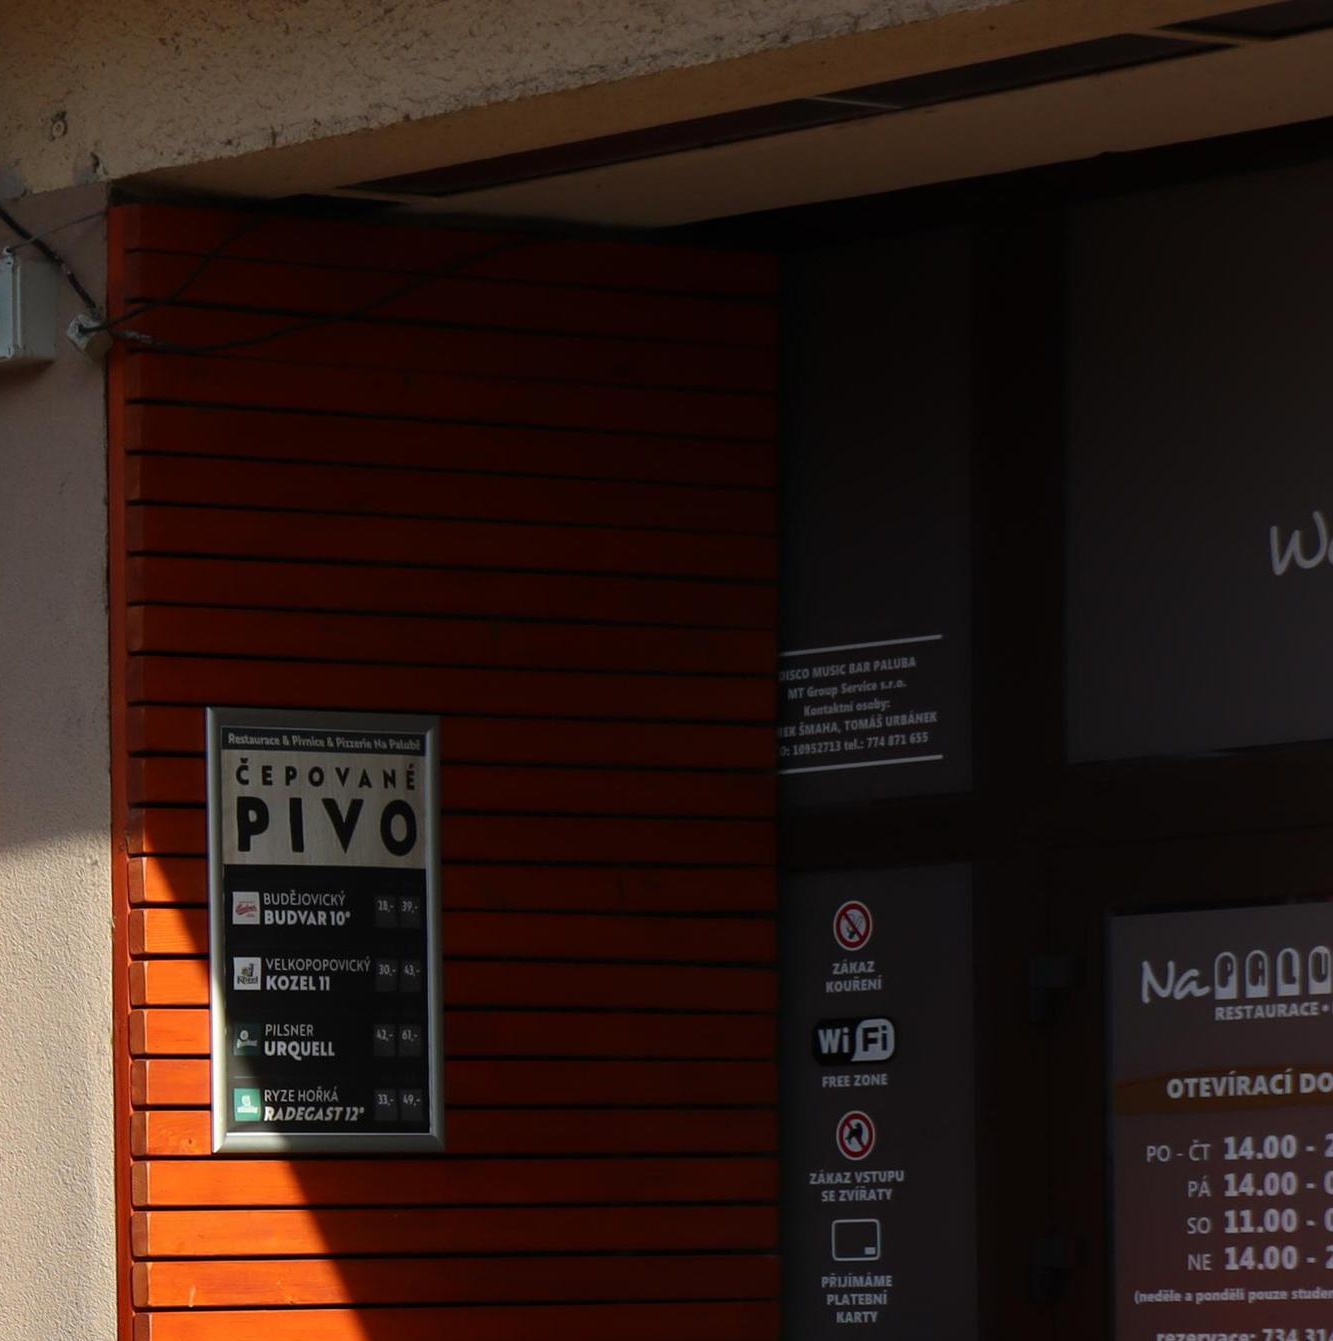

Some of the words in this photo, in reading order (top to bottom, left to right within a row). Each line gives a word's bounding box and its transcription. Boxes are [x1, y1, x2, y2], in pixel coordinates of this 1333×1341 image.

[813, 664, 846, 678] MUSIC
[849, 661, 871, 674] BAR
[873, 656, 917, 671] PALUBA
[788, 687, 804, 700] MT
[807, 684, 838, 698] Group
[841, 680, 878, 695] Service
[880, 680, 907, 690] s.r.o.
[844, 717, 883, 732] TOMÁŠ
[885, 710, 938, 727] URBÁNEK
[228, 732, 281, 745] Restaurace
[282, 735, 291, 745] &
[292, 735, 325, 747] Pivnice
[326, 736, 334, 747] &
[335, 736, 372, 749] Pizzerie
[374, 738, 388, 749] Na
[867, 737, 886, 748] 774
[909, 732, 929, 744] 655
[236, 757, 415, 790] ČEPOVANÉ
[236, 796, 417, 856] PIVO
[263, 890, 346, 906] BUDĚJOVICKÝ
[264, 910, 327, 926] BUDVAR
[265, 956, 371, 972] VELKOPOPOVICKÝ
[832, 958, 875, 975] ZÁKAZ
[265, 976, 317, 991] KOZEL
[319, 976, 331, 991] 11
[825, 974, 883, 993] KOUŘENÍ
[1141, 960, 1211, 1004] Na
[1214, 1002, 1320, 1020] RESTAURACE
[265, 1024, 314, 1037] PILSNER
[264, 1041, 335, 1060] URQUELL
[821, 1075, 851, 1088] FREE
[853, 1073, 889, 1087] ZONE
[1166, 1068, 1294, 1099] OTEVÍRACÍ
[264, 1089, 294, 1102] RYZE
[297, 1086, 339, 1102] HOŘKÁ
[264, 1106, 344, 1121] RADEGAST
[1146, 1145, 1171, 1162] PO
[1188, 1139, 1212, 1161] ČT
[1222, 1134, 1298, 1160] 14.00
[809, 1169, 851, 1185] ZÁKAZ
[854, 1169, 905, 1183] VSTUPU
[1188, 1176, 1212, 1197] PÁ
[1222, 1171, 1299, 1197] 14.00
[821, 1190, 836, 1202] SE
[838, 1185, 893, 1202] ZVÍŘATY
[1186, 1217, 1212, 1234] SO
[1223, 1208, 1299, 1234] 11.00
[1188, 1254, 1213, 1271] NE
[1223, 1245, 1299, 1270] 14.00
[821, 1272, 893, 1288] PŘIJÍMÁME
[826, 1289, 888, 1306] PLATEBNÍ
[1134, 1289, 1182, 1304] (neděle
[1184, 1293, 1193, 1301] a
[1247, 1290, 1287, 1303] pouze
[836, 1311, 878, 1323] KARTY
